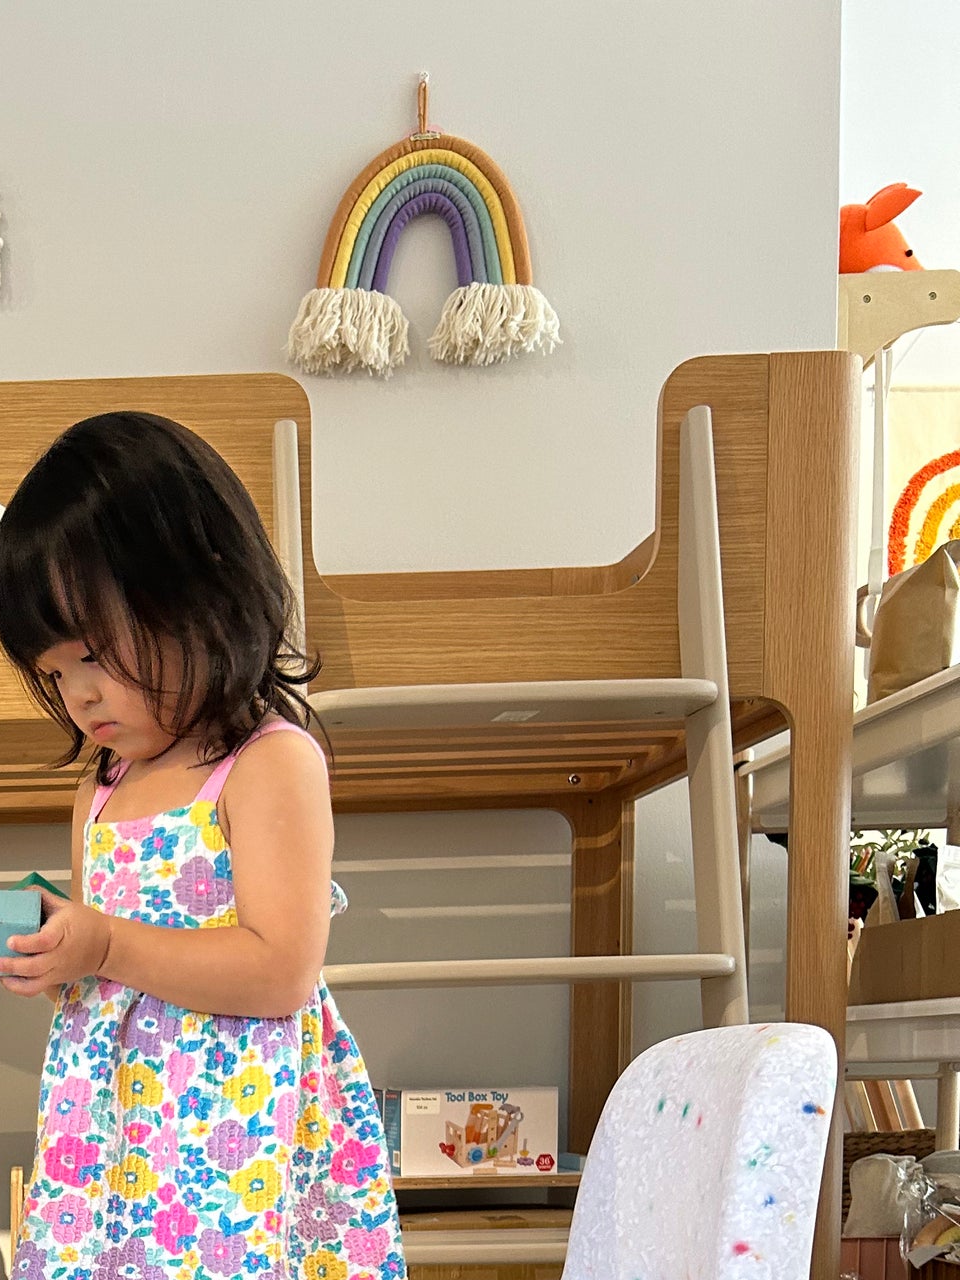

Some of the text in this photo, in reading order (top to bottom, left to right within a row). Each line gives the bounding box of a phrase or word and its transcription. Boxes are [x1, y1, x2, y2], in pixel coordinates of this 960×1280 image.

[445, 1092, 465, 1103] Tool
[468, 1091, 487, 1102] Box
[491, 1090, 509, 1104] Toy
